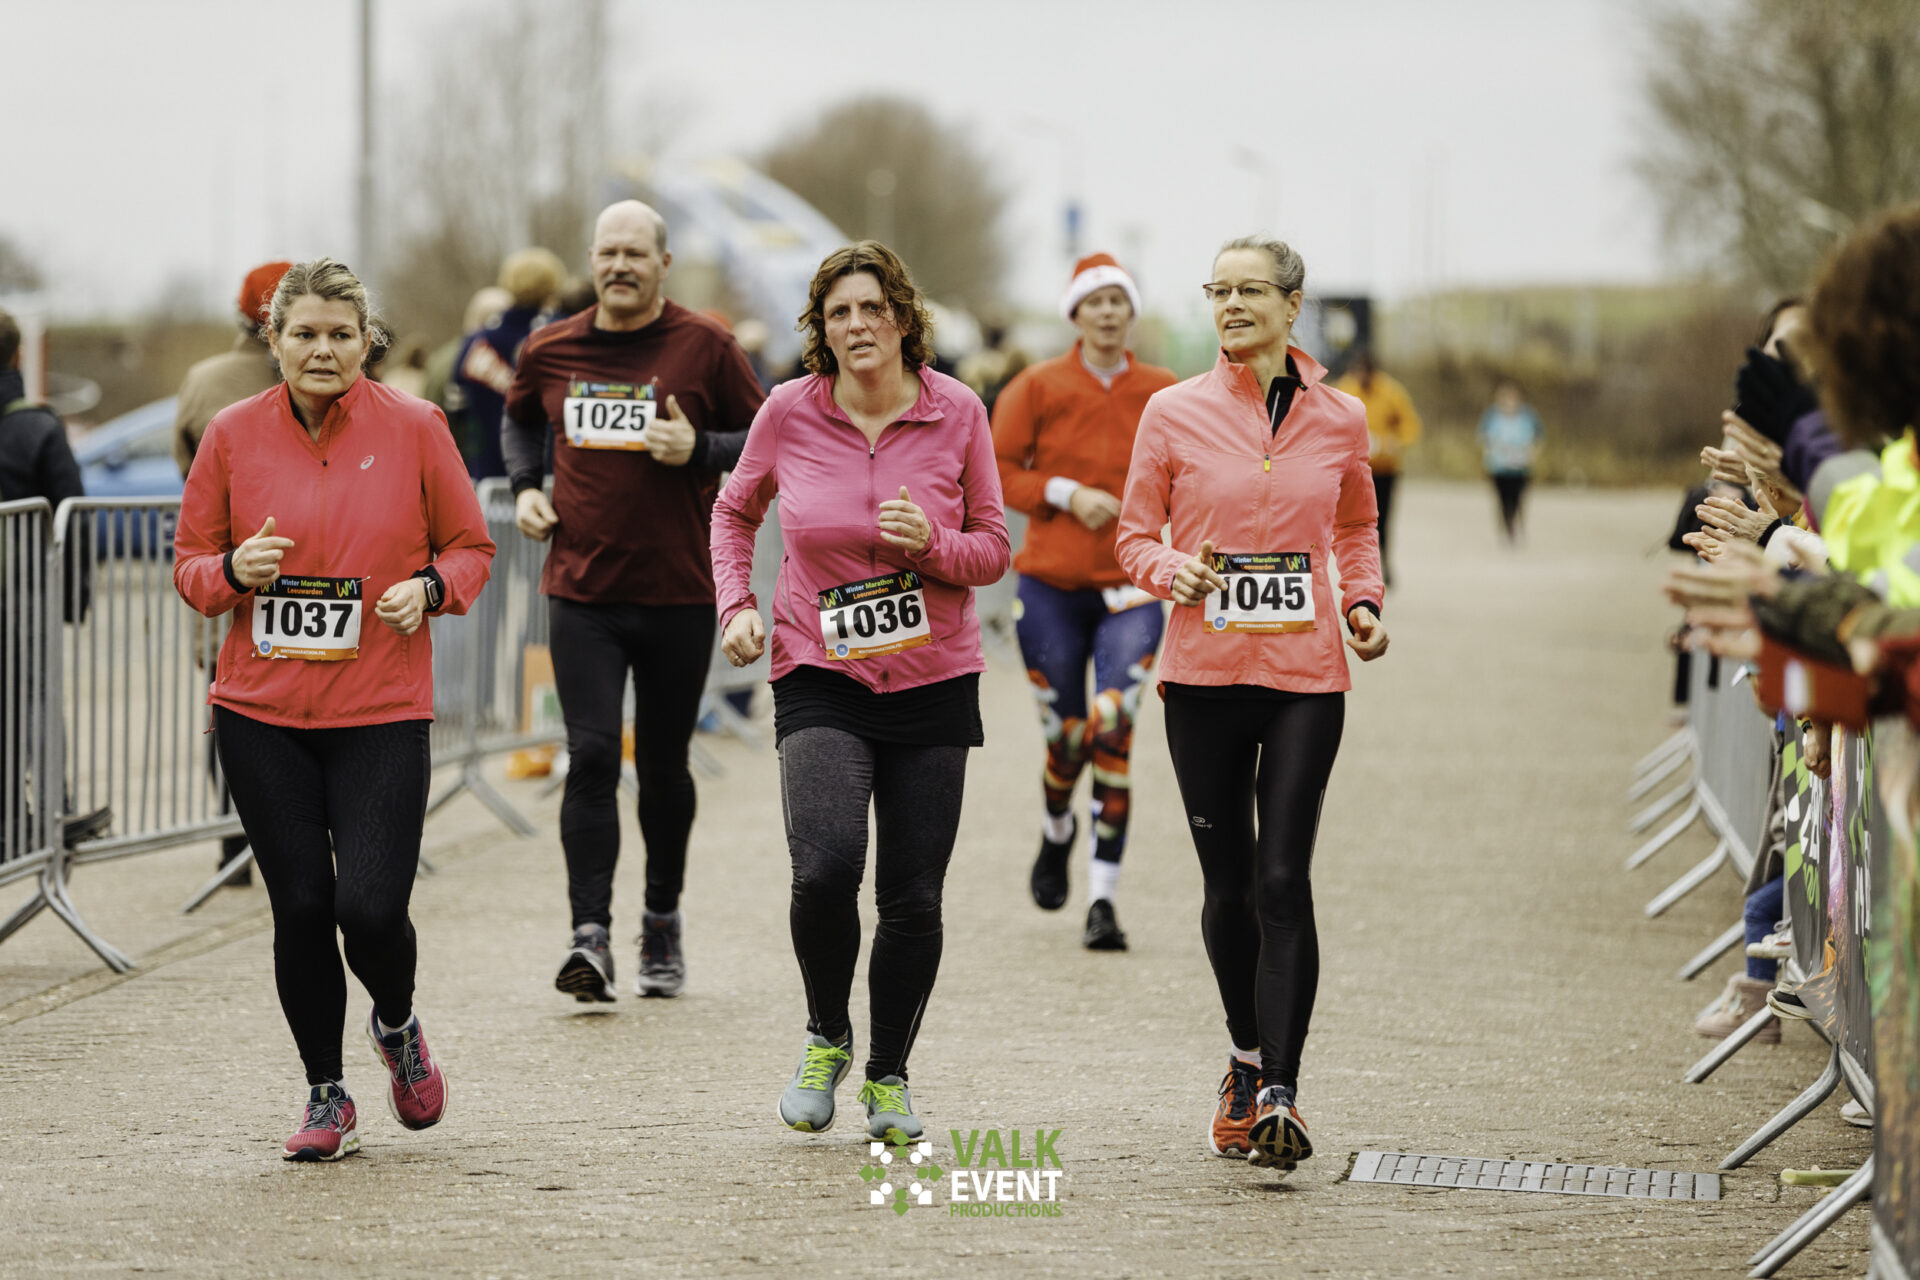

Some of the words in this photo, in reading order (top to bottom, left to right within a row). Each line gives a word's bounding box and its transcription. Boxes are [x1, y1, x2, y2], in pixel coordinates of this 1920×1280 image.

[574, 402, 645, 431] 1025
[281, 579, 300, 587] Winter
[301, 580, 330, 588] Marathon
[287, 587, 323, 595] Leeuwarden
[845, 584, 864, 593] Winter
[865, 579, 894, 588] Marathon
[853, 587, 889, 599] Leeuwarden
[1220, 577, 1305, 610] 1045
[261, 599, 353, 637] 1037
[830, 594, 921, 639] 1036
